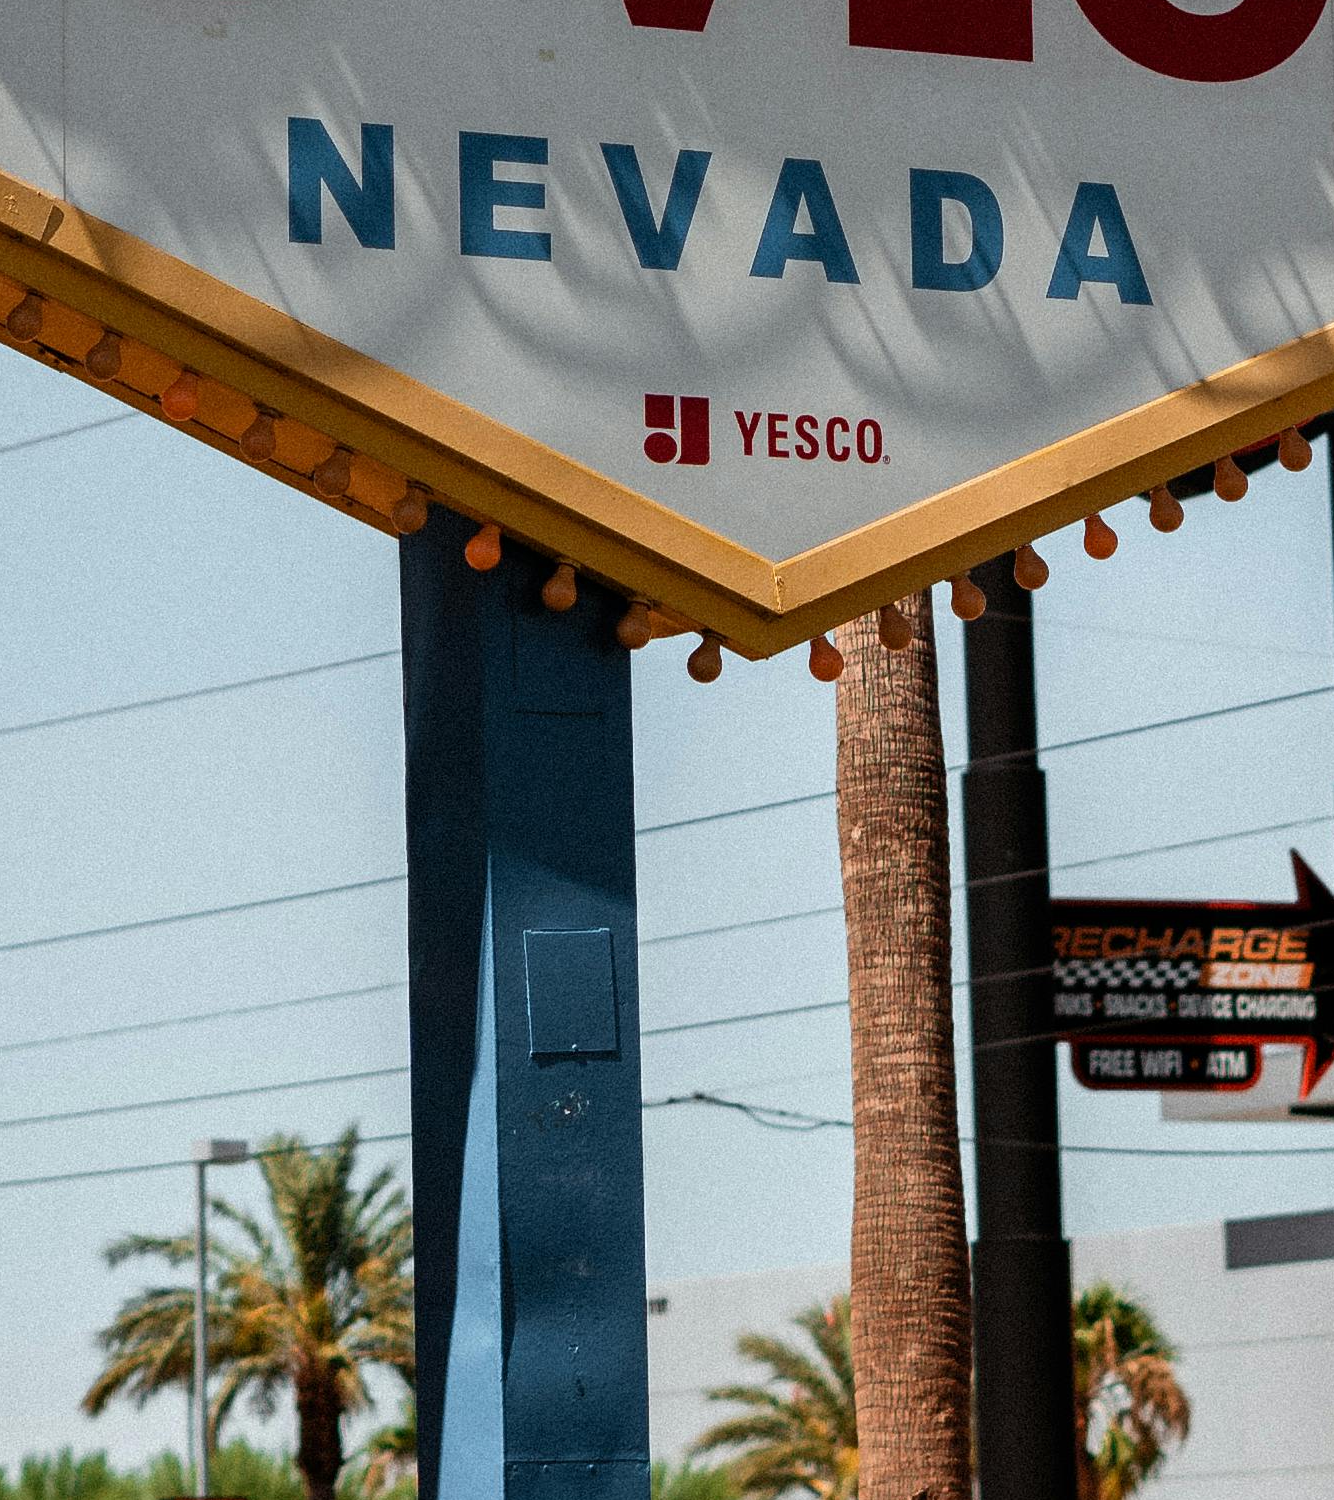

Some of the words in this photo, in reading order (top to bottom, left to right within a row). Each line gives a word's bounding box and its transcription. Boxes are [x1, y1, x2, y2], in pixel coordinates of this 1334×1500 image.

[287, 116, 1153, 306] NEVADA
[1208, 962, 1305, 989] ZONE
[1235, 994, 1316, 1021] CHARGING
[1088, 1049, 1135, 1077] FREE
[1206, 1051, 1247, 1079] ATM
